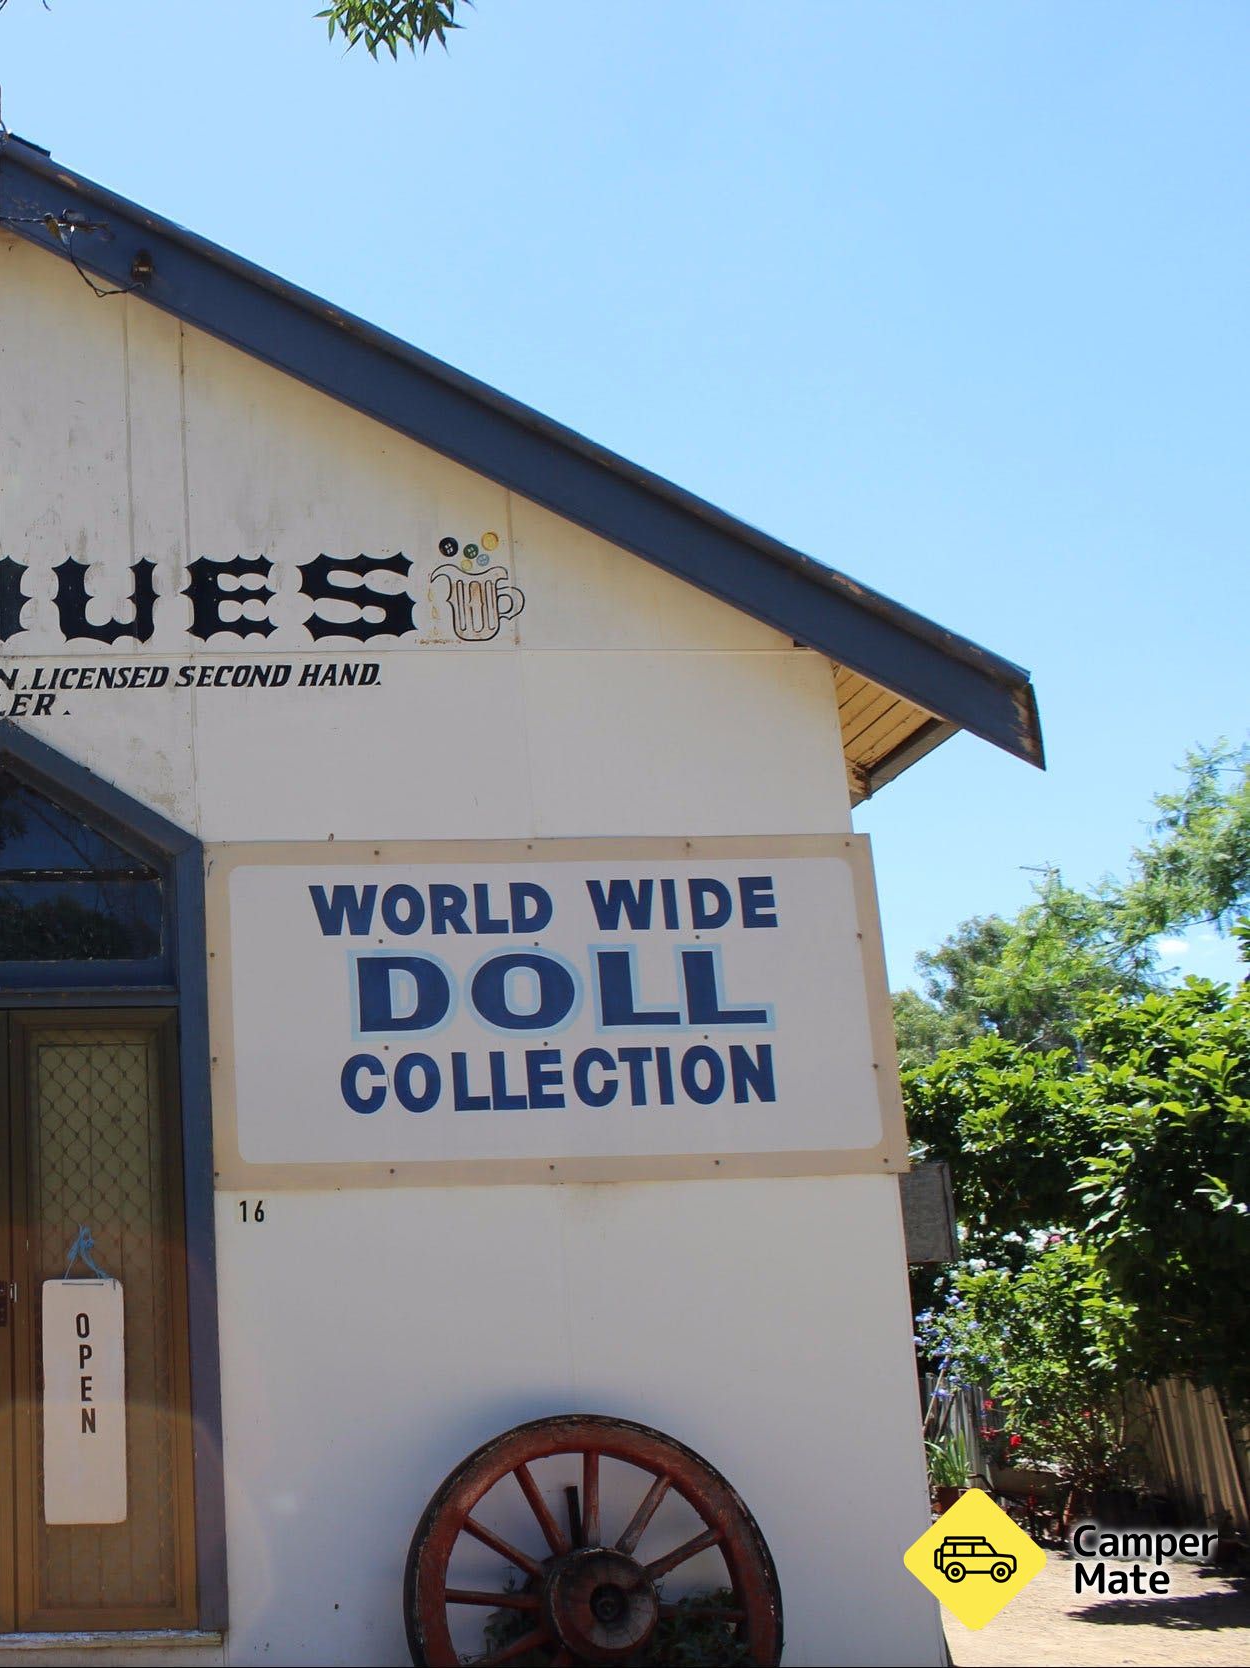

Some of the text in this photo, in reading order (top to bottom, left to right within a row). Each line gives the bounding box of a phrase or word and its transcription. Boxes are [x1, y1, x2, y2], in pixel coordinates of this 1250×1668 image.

[174, 664, 293, 688] SECOND
[308, 876, 779, 937] WORLD WIDE
[347, 943, 775, 1042] DOLL
[340, 1043, 776, 1115] COLLECTION
[239, 1200, 265, 1223] 16
[75, 1312, 96, 1434] OPEN
